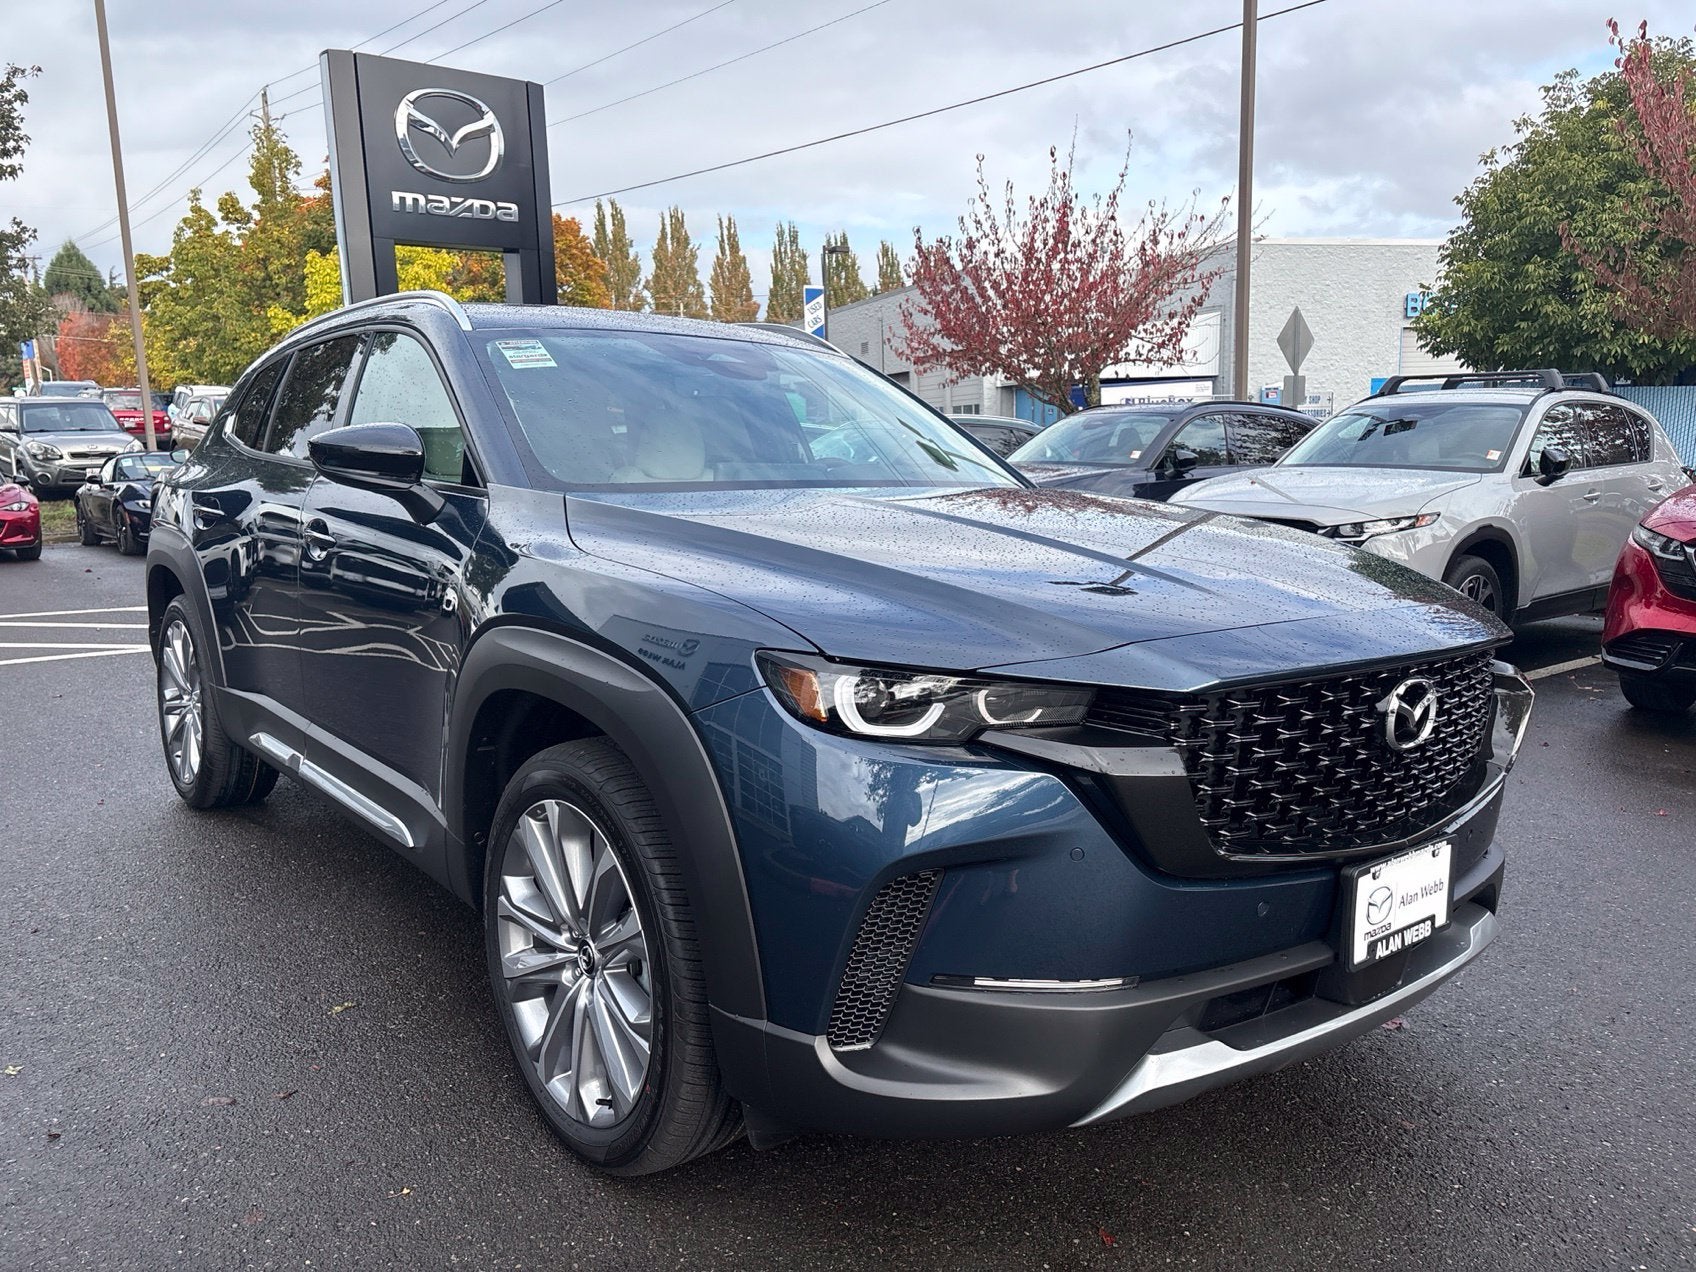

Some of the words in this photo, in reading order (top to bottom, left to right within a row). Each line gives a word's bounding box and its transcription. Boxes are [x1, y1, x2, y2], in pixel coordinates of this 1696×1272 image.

[391, 190, 519, 222] mazda
[807, 302, 822, 314] USED
[808, 315, 822, 328] CARS
[1399, 892, 1419, 909] Alan
[1420, 878, 1444, 899] Webb
[1364, 923, 1392, 941] mazda
[1375, 932, 1402, 960] ALAN
[1403, 919, 1432, 946] WEBB
